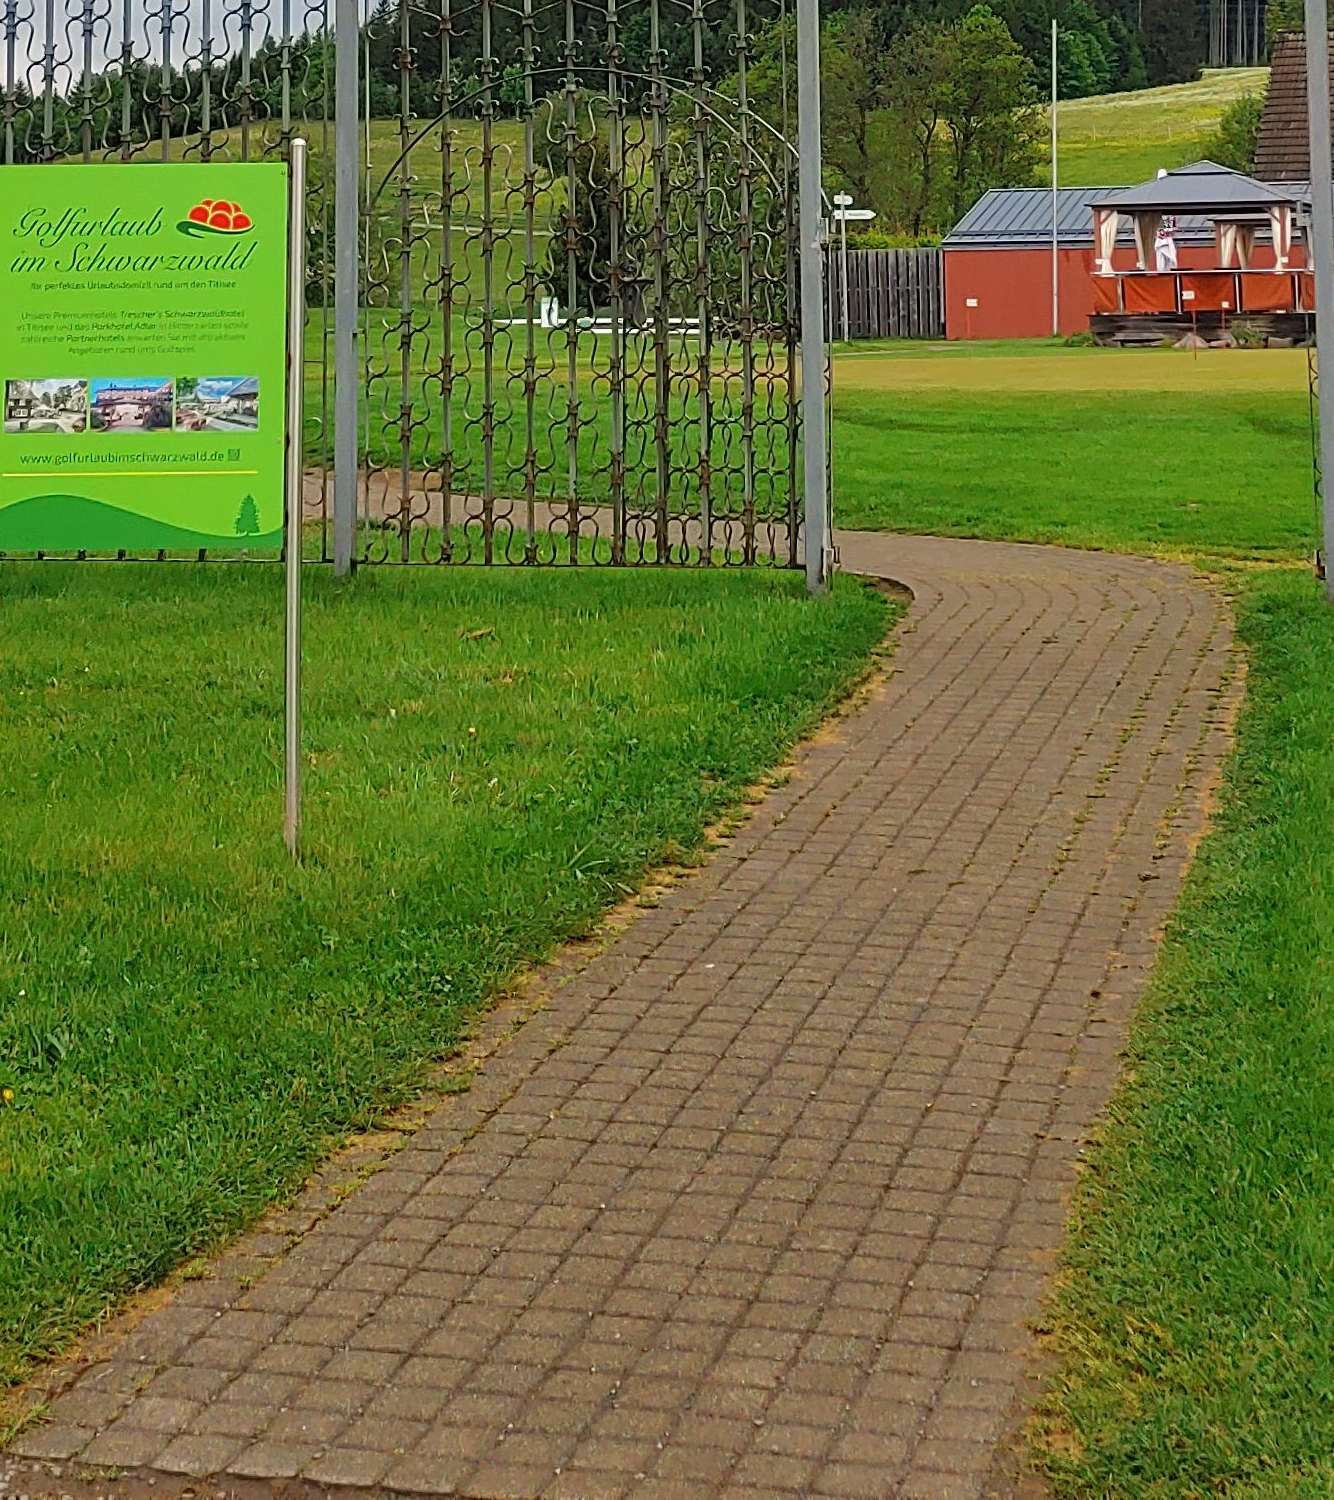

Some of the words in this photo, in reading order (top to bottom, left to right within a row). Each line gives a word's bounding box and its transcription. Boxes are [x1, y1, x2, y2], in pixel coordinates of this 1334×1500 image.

[12, 206, 165, 248] Golfurlaub
[10, 249, 48, 273] im
[54, 241, 259, 273] Schwarzwald
[44, 281, 86, 293] perfektes
[87, 280, 152, 291] Urlaubsdomizil
[153, 280, 173, 290] rund
[175, 281, 189, 289] um
[190, 279, 207, 289] den
[208, 279, 237, 289] Titisee
[91, 321, 134, 332] Parkhotel
[134, 321, 157, 331] Adler
[66, 333, 125, 343] Partnerhotels
[19, 449, 225, 467] www.golfurlaubimschwarzwald.de
